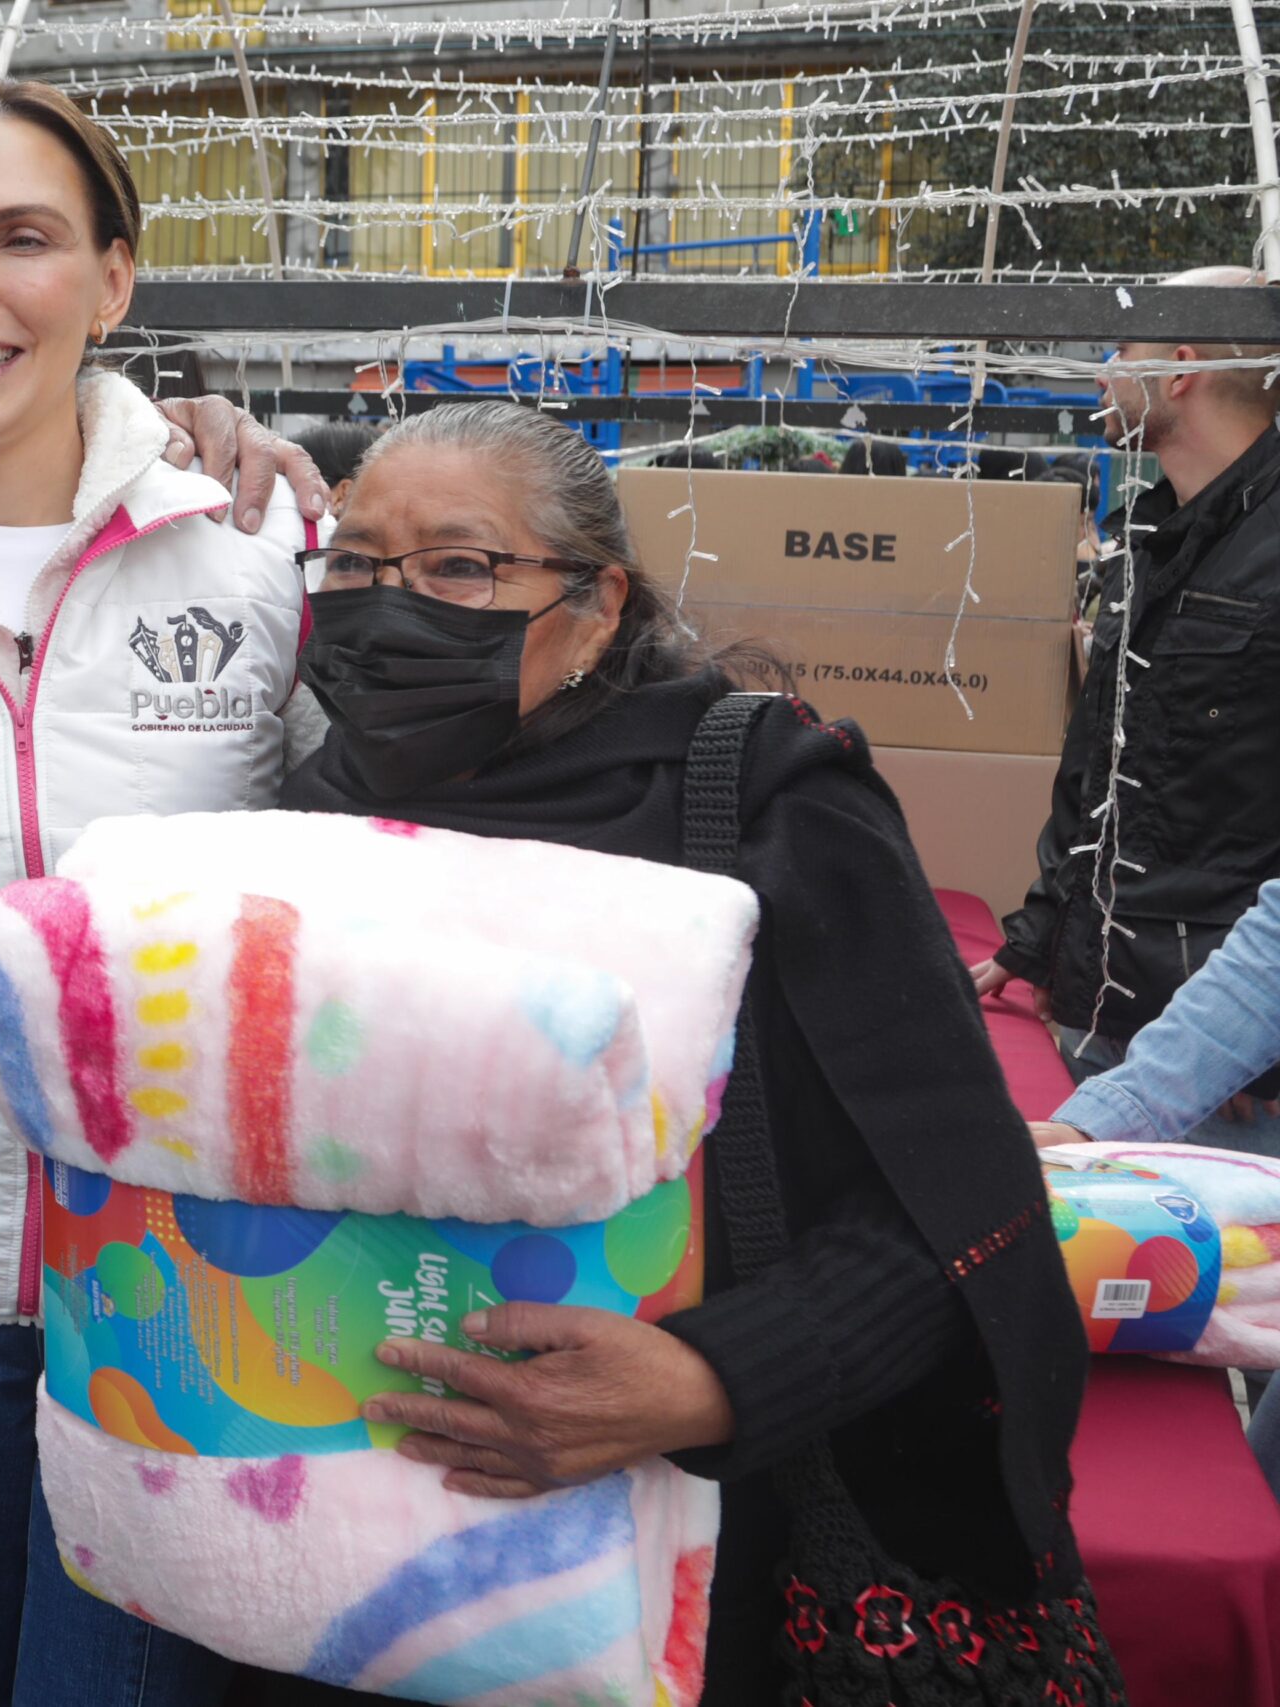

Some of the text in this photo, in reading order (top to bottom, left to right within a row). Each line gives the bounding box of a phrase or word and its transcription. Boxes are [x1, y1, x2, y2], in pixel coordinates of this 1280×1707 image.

[784, 529, 897, 563] BASE
[813, 664, 989, 692] (75.0X44.0X46.0)
[130, 687, 253, 720] Puebla
[131, 723, 254, 732] GOBIERNO DE LA CIUDAD
[414, 1252, 449, 1312] Light
